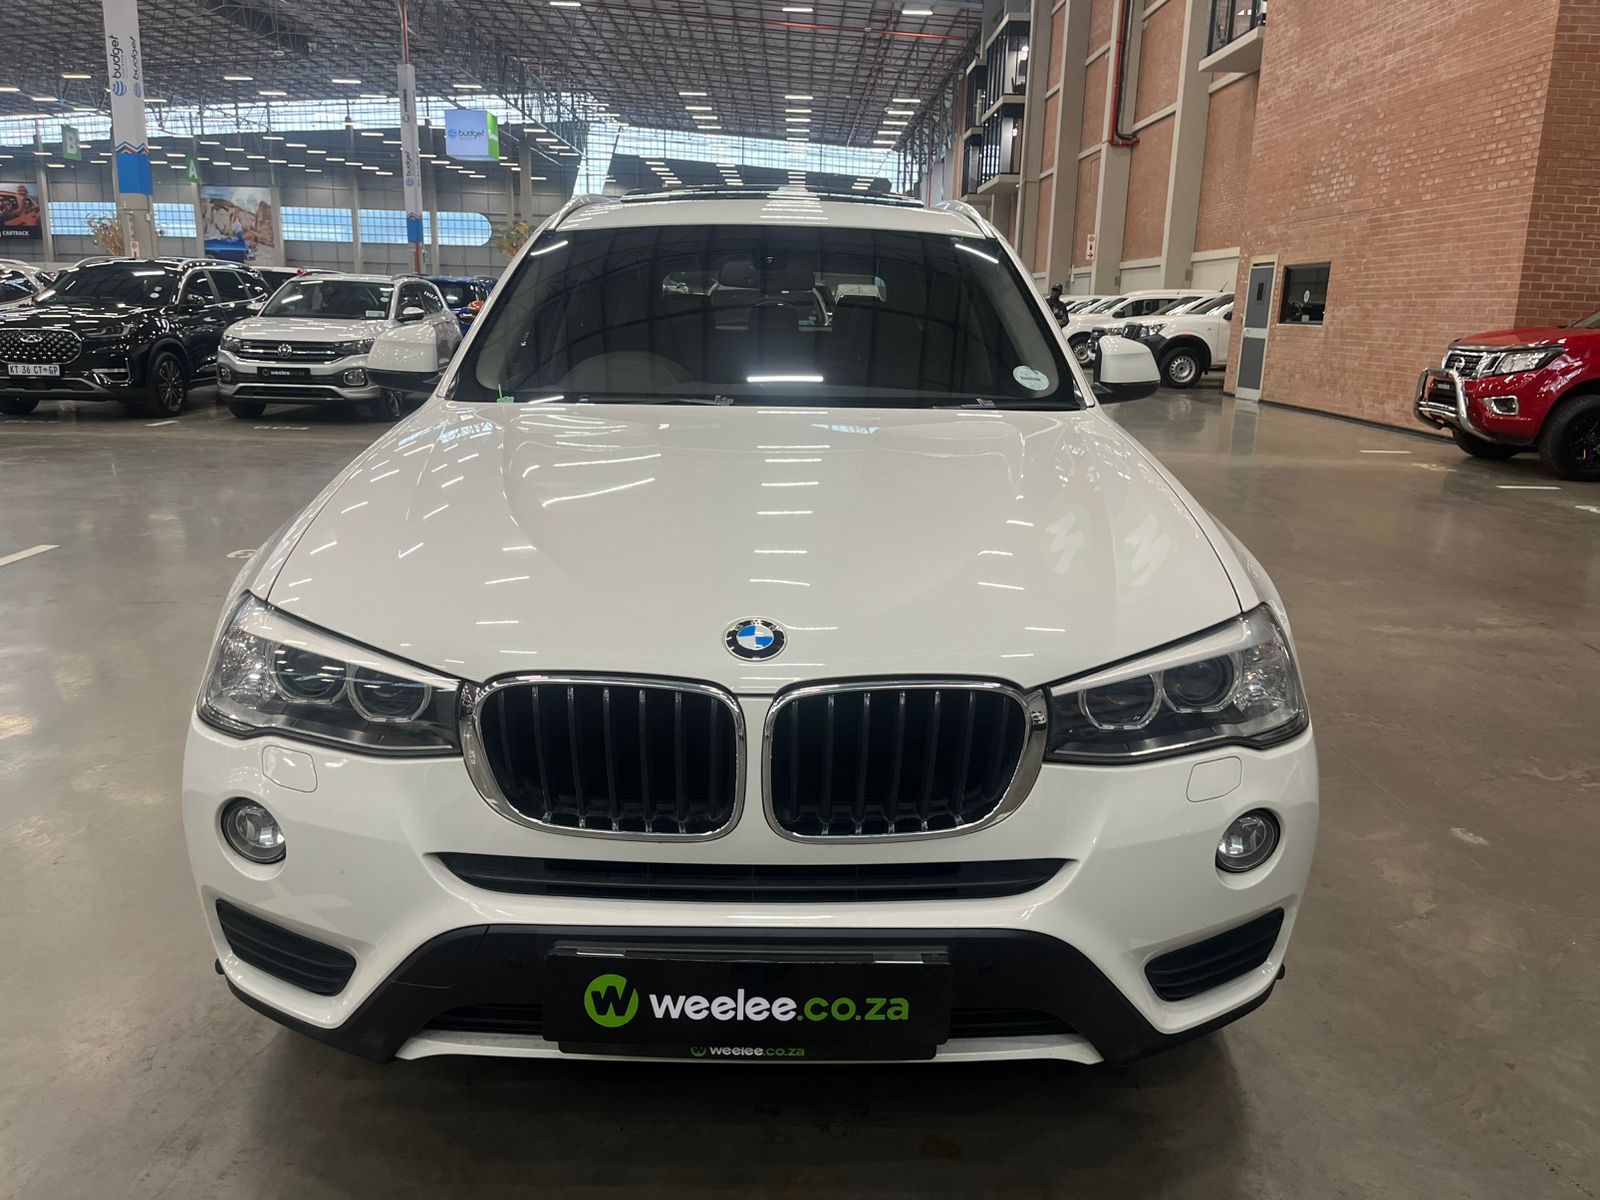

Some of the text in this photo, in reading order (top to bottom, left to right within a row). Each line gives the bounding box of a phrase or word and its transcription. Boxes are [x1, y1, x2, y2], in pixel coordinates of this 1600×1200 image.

[108, 34, 124, 79] budget
[458, 127, 485, 140] budget
[188, 159, 198, 179] A
[10, 365, 19, 374] KT
[649, 988, 910, 1021] weelee.co.za
[709, 1046, 805, 1057] weelee.co.za
